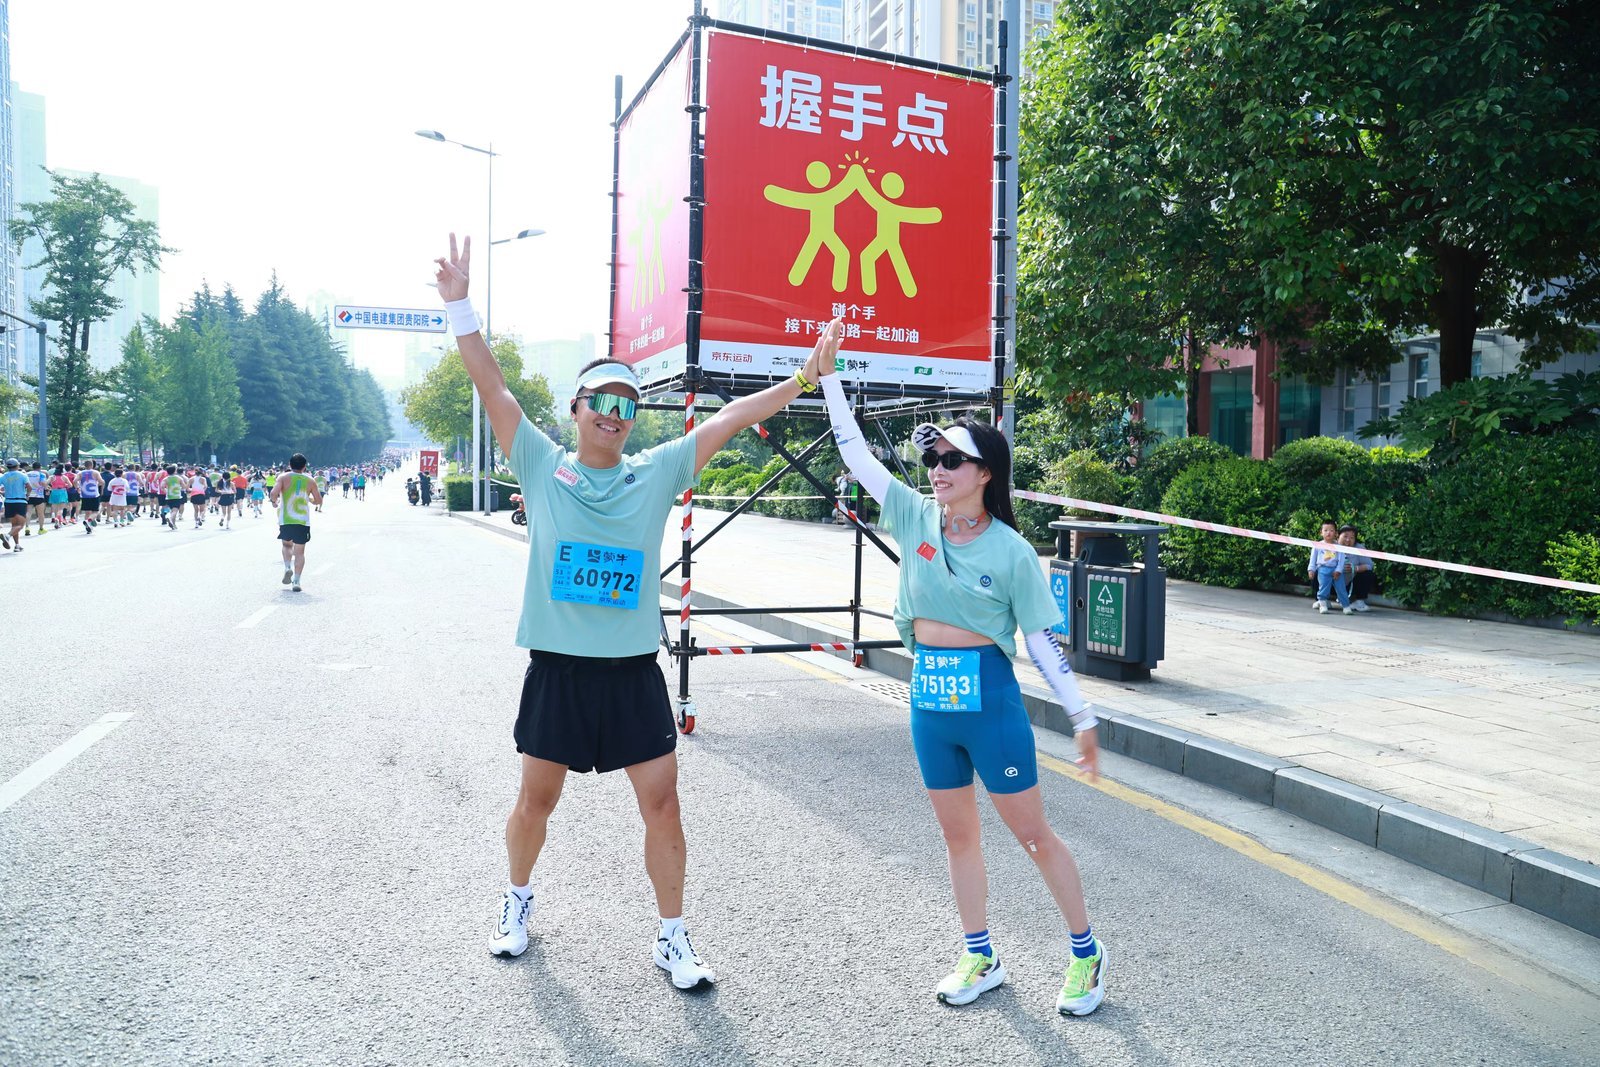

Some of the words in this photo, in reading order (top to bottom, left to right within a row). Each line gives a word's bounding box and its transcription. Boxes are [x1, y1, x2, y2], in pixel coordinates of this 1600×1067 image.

[759, 65, 949, 156] 握手点
[354, 311, 430, 327] 中国电建集团贵阳院
[832, 302, 876, 320] 碰个手
[711, 351, 753, 363] 京东运动
[847, 360, 869, 373] 蒙牛
[421, 455, 435, 467] 17
[559, 545, 572, 562] E
[603, 551, 628, 566] 蒙牛
[573, 567, 635, 592] 60972
[936, 655, 962, 670] 蒙牛
[919, 674, 971, 695] 75133
